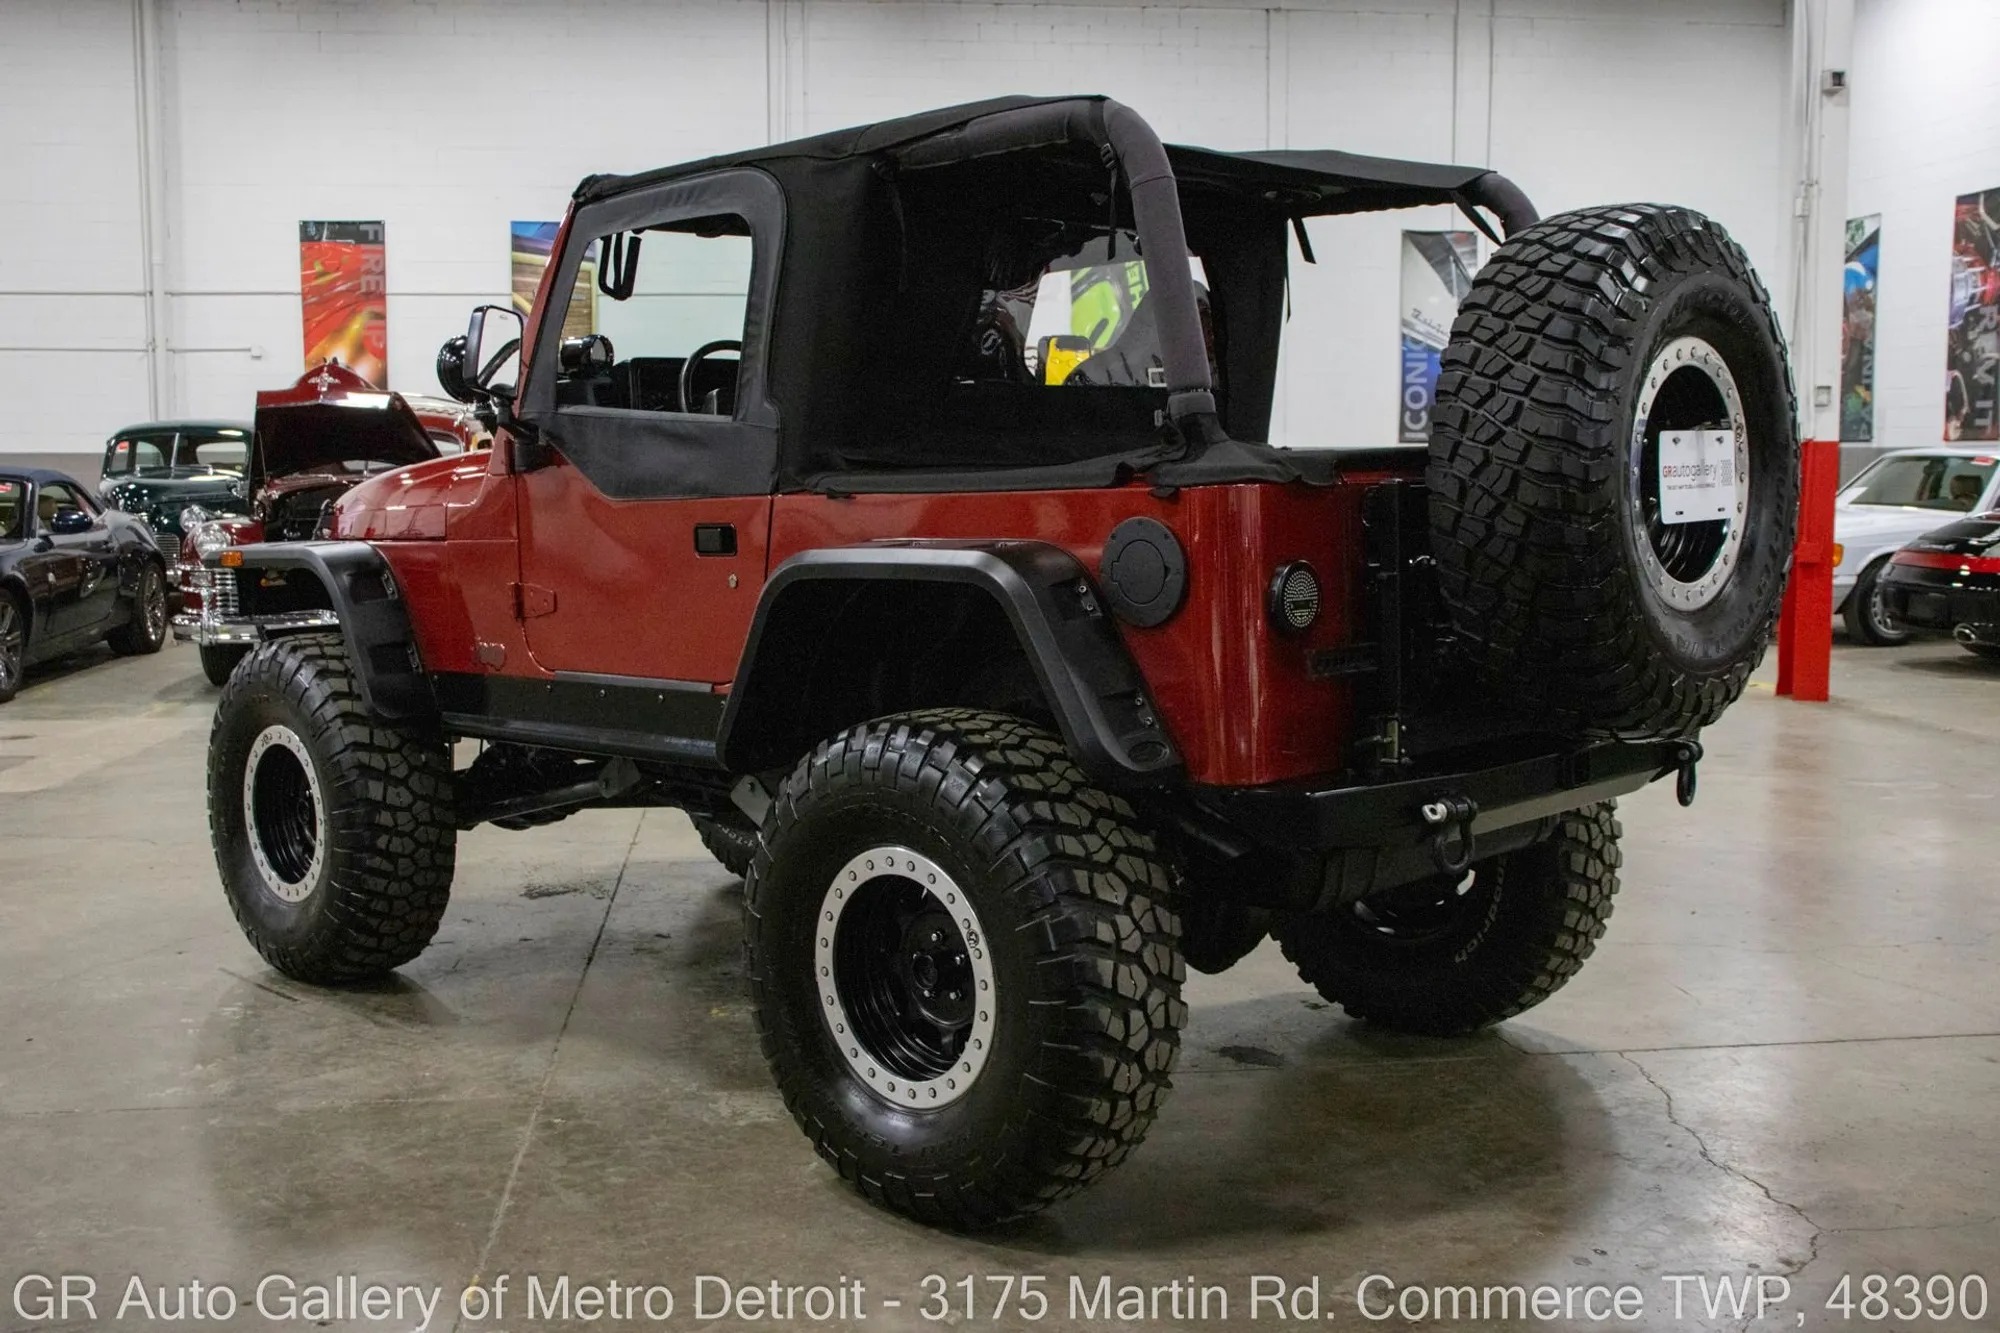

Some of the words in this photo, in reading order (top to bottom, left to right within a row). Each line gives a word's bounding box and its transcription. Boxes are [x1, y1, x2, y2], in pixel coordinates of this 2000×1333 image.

[359, 224, 384, 293] FIRE
[1860, 338, 1873, 440] PAINA
[1974, 399, 1993, 434] IT
